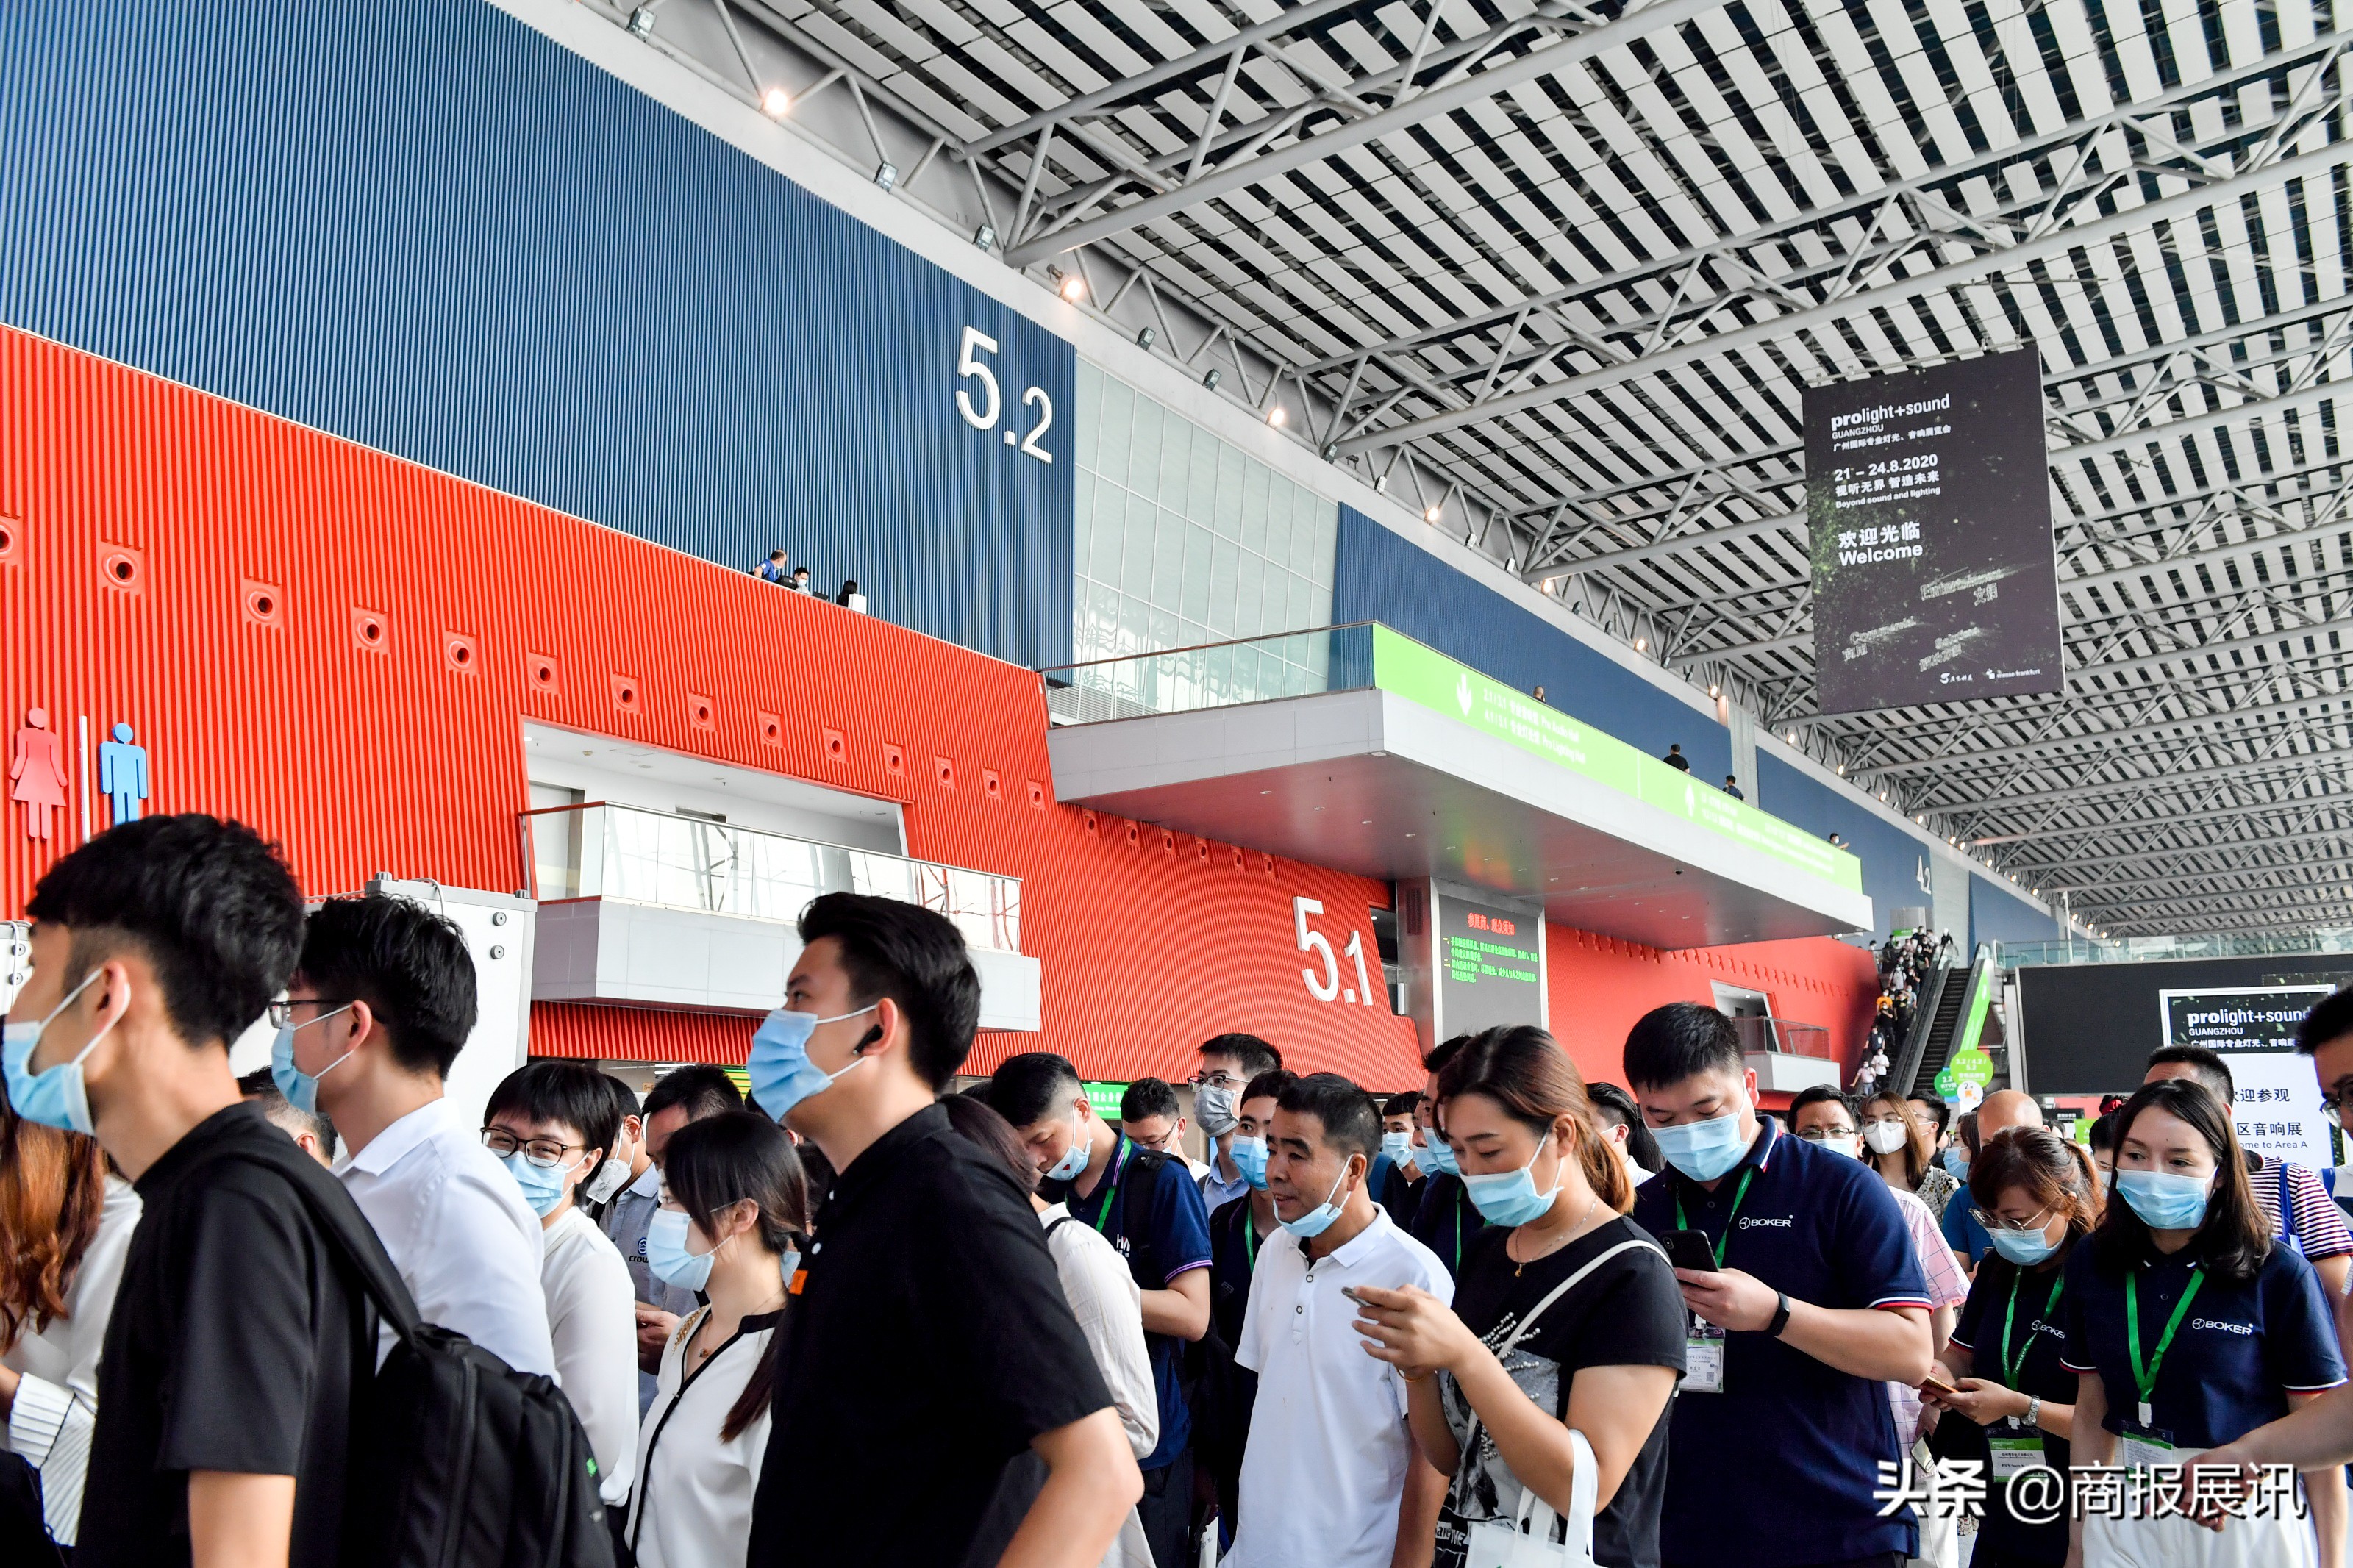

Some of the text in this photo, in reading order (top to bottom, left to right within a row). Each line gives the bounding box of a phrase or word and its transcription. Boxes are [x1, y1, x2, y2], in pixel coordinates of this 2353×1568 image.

[956, 326, 1052, 464] 5.2
[1831, 393, 1950, 431] prolight+sound
[1832, 423, 1884, 440] GUANGZHOU
[1834, 468, 1850, 482] 21
[1868, 454, 1938, 476] 24.8.2020
[1835, 470, 1940, 497] 视听无界 智造未来
[1835, 487, 1941, 509] Beyond sound and lighting
[1838, 521, 1921, 549] 欢迎光临
[1839, 544, 1923, 566] Welcome
[2015, 668, 2040, 677] frankfurt
[1917, 855, 1932, 895] 4.2
[1293, 896, 1373, 1006] 5.1
[2188, 1028, 2243, 1036] GUANGZHOU
[2237, 1122, 2302, 1136] 区音响展
[1751, 1218, 1792, 1227] BOKER
[2205, 1320, 2252, 1335] BOKER
